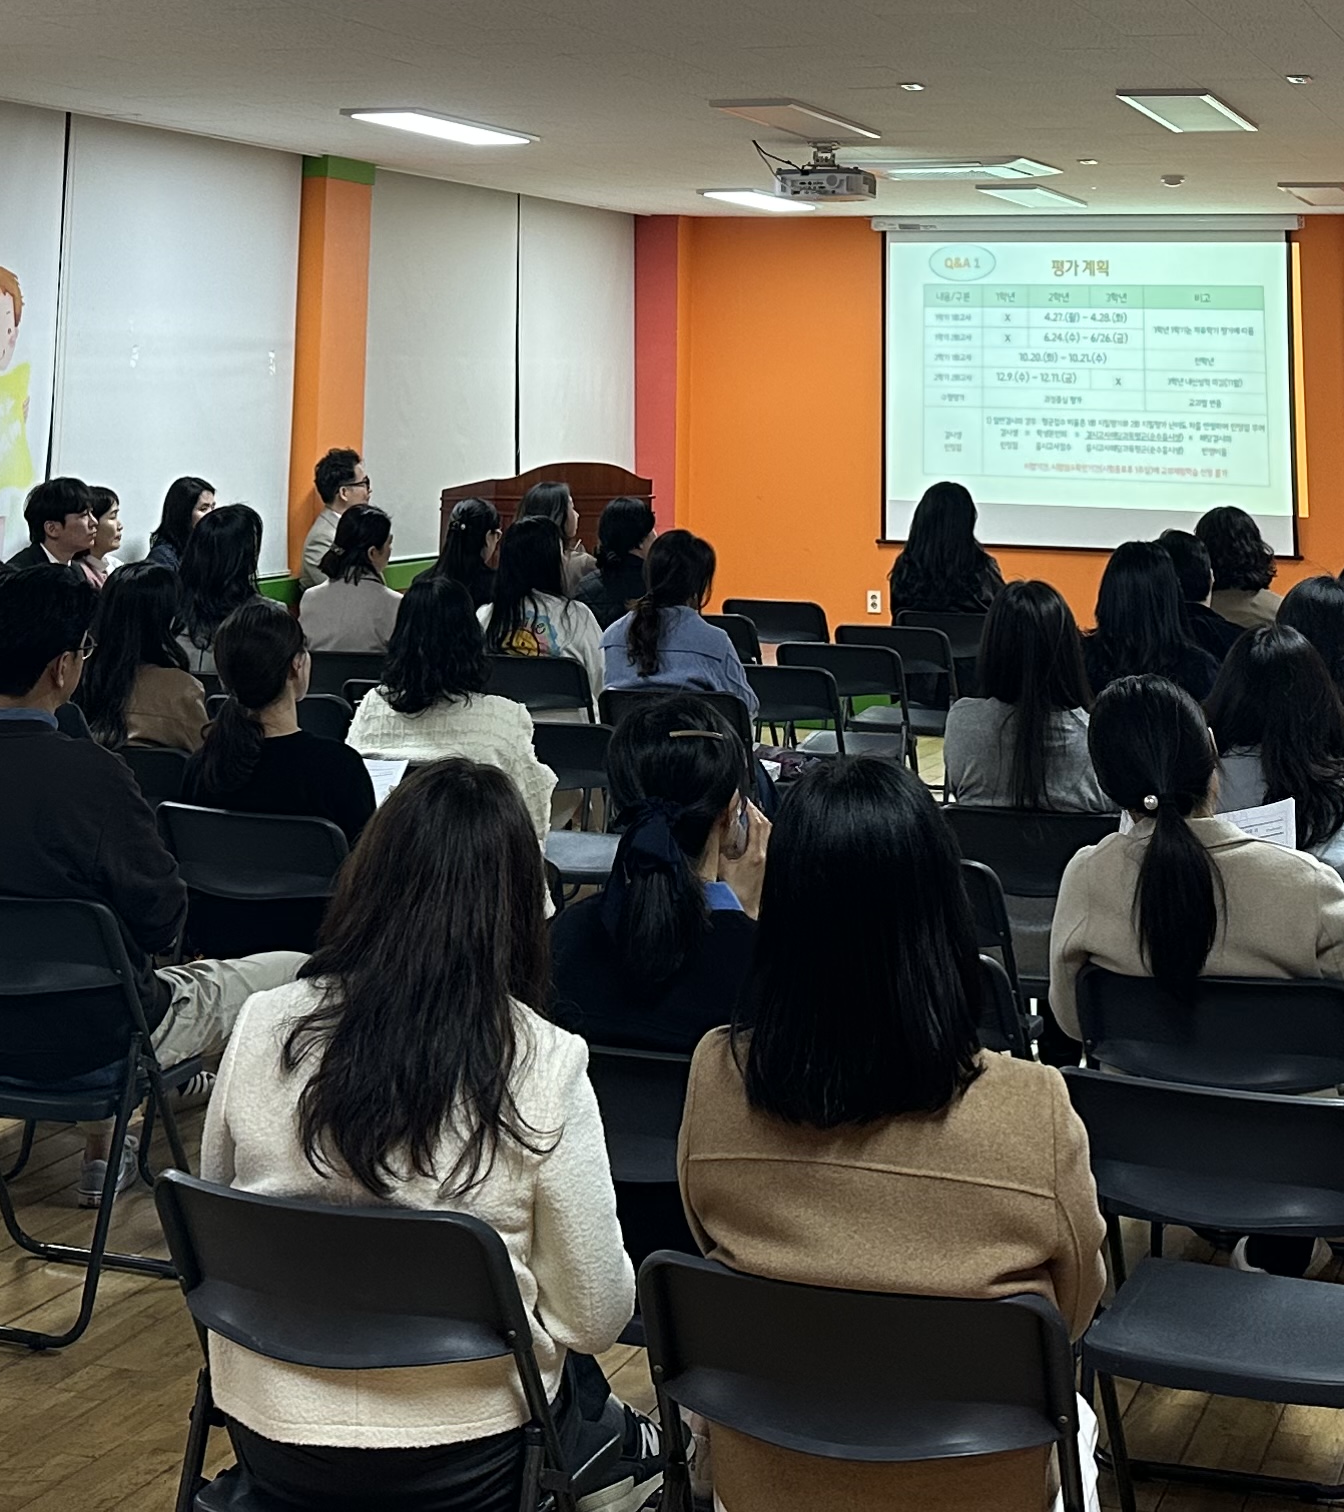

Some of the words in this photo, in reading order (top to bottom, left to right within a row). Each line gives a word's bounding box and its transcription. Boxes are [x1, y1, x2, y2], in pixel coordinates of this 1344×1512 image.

[944, 257, 971, 270] Q&A
[974, 258, 981, 269] 1
[1051, 259, 1080, 277] 평가
[1082, 259, 1110, 277] 계획
[1048, 292, 1070, 303] 2학년
[1105, 292, 1127, 304] 3학년
[1194, 293, 1211, 303] 비고
[639, 1422, 660, 1460] N
